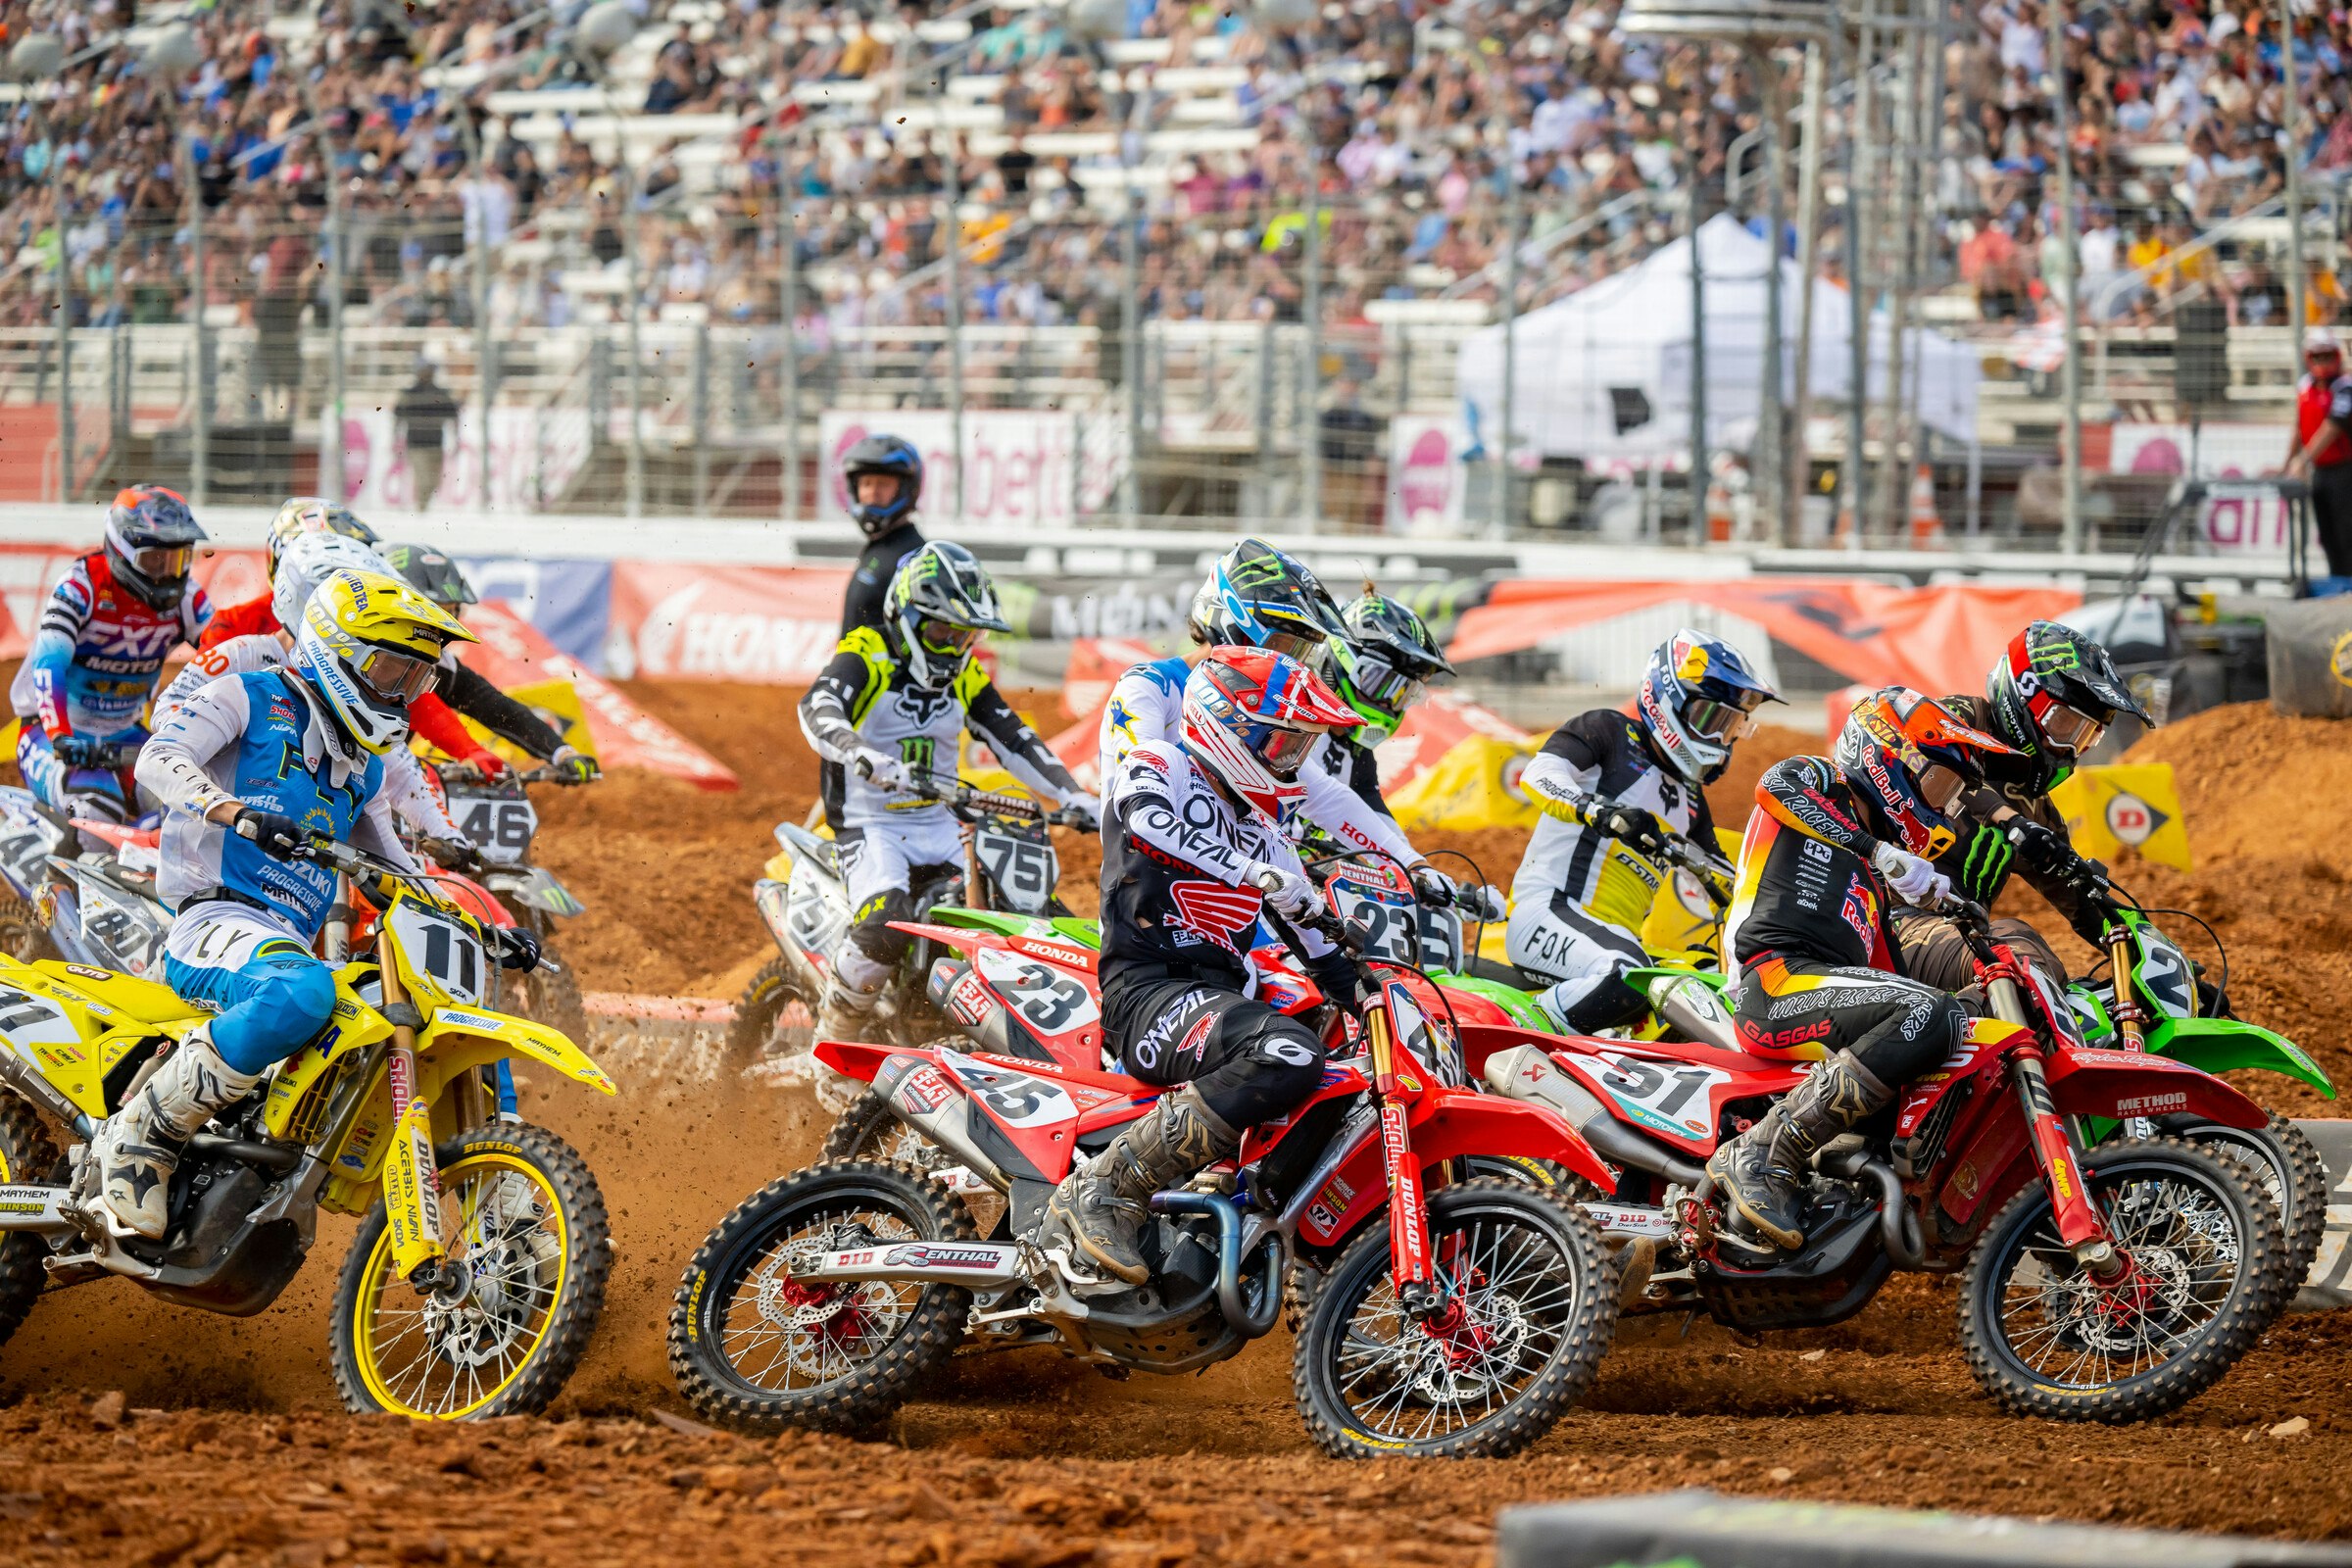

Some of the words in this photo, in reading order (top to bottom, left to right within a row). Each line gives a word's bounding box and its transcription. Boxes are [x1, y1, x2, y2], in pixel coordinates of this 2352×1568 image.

[353, 591, 370, 613] TEA
[86, 656, 160, 674] MOTO
[192, 649, 230, 677] 80
[307, 640, 361, 706] PROGRESSIVE
[1659, 664, 1677, 696] FOX
[1188, 677, 1251, 737] 100%
[1189, 702, 1202, 723] BELL
[1863, 743, 1885, 778] Red
[1875, 769, 1904, 807] Bull
[1783, 795, 1853, 845] RACERS
[1802, 787, 1860, 830] GASGAS
[461, 804, 530, 848] 46
[984, 837, 1048, 893] 75
[1805, 842, 1831, 859] PPG
[1340, 868, 1387, 887] RENTHAL
[1615, 853, 1660, 889] ECSTAR
[257, 864, 323, 912] PROGRESSIVE
[1352, 900, 1418, 966] 23
[1524, 925, 1576, 966] FOX
[417, 923, 476, 997] 11
[1021, 941, 1089, 968] HONDA
[67, 964, 112, 979] GUTS
[988, 963, 1087, 1030] 23
[442, 1012, 503, 1031] PROGRESSIVE
[1743, 1019, 1833, 1048] GASGAS
[526, 1037, 563, 1057] MAYHEM
[984, 1053, 1064, 1074] HONDA
[388, 1055, 412, 1128] SHOW
[955, 1067, 1064, 1119] 45
[1601, 1055, 1712, 1117] 51
[2117, 1091, 2187, 1111] METHOD
[2117, 1107, 2142, 1117] RACE
[2147, 1102, 2188, 1114] WHEELS
[1643, 1113, 1688, 1138] MOTOREX
[463, 1140, 523, 1154] DUNLOP
[0, 1189, 50, 1199] MAYHEM
[416, 1138, 440, 1236] DUNLOP
[1400, 1176, 1422, 1257] DUNLOP
[1619, 1213, 1647, 1223] DID
[838, 1251, 874, 1266] DID
[884, 1244, 1002, 1268] RENTHAL
[688, 1269, 708, 1343] DUNLOP
[1340, 1427, 1412, 1450] DUNLOP
